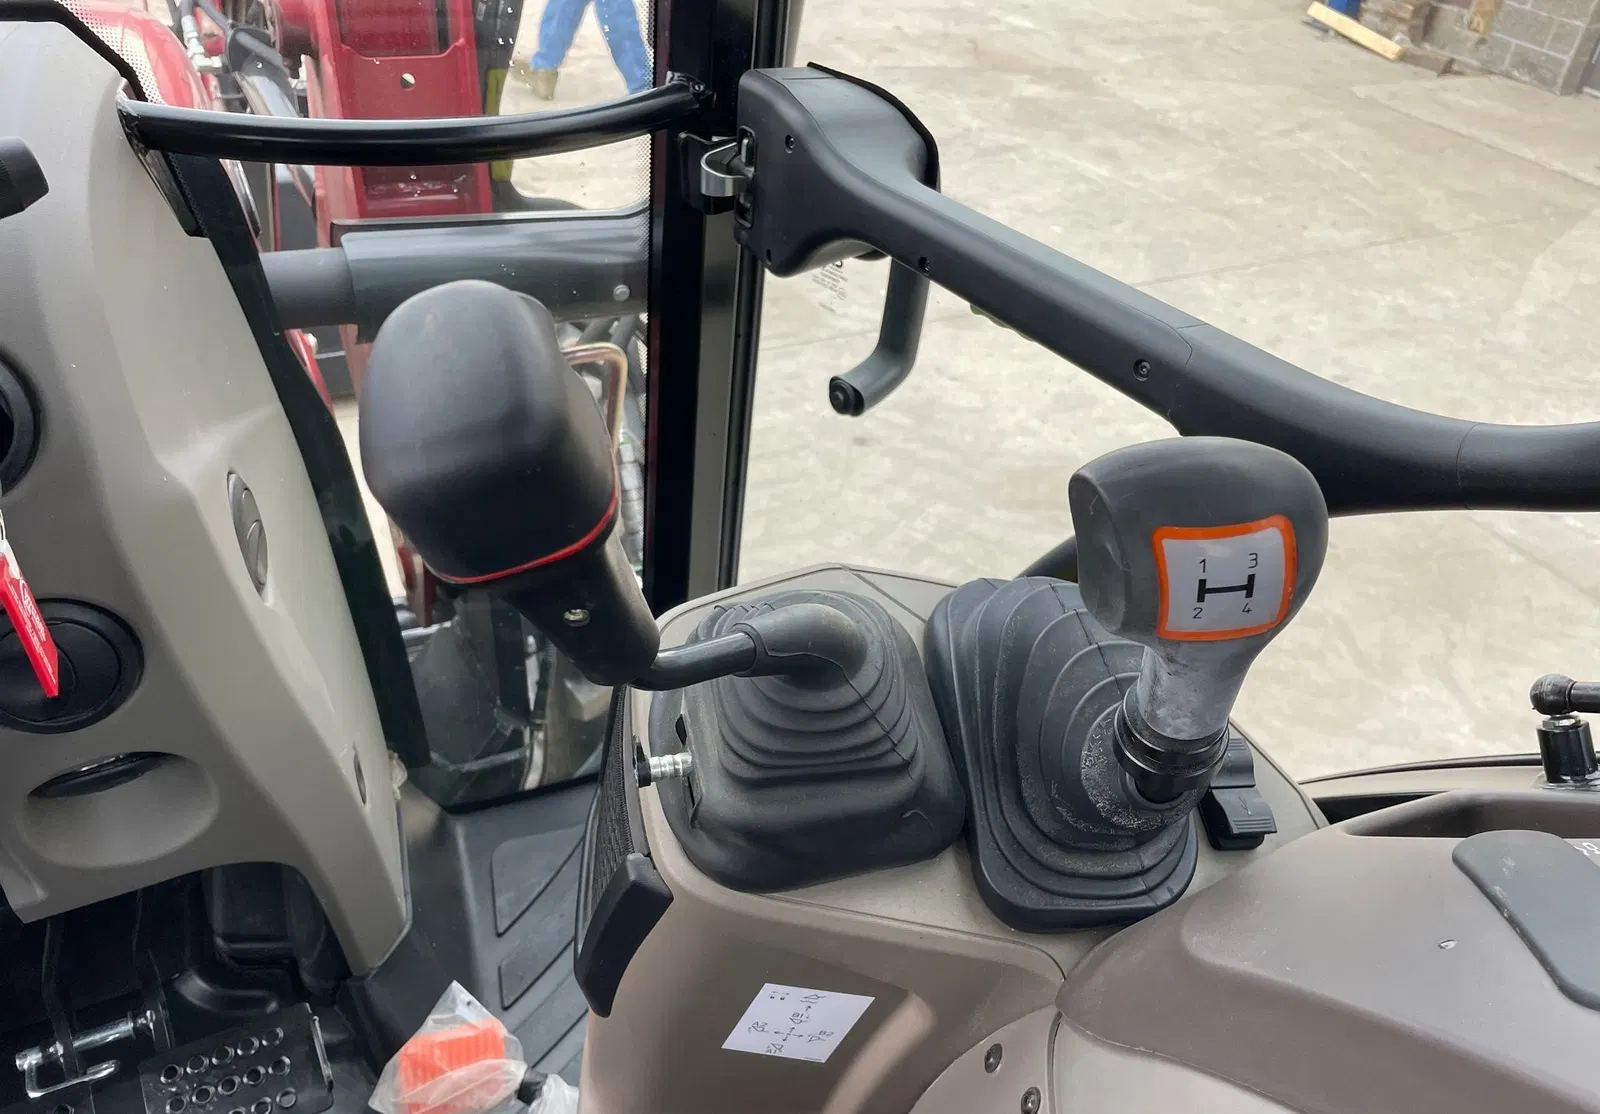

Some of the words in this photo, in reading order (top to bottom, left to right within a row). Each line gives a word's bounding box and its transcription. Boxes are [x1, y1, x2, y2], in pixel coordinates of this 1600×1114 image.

[1199, 558, 1206, 574] 1
[1248, 553, 1258, 569] 3
[1192, 607, 1203, 619] 2
[1242, 603, 1252, 614] 4
